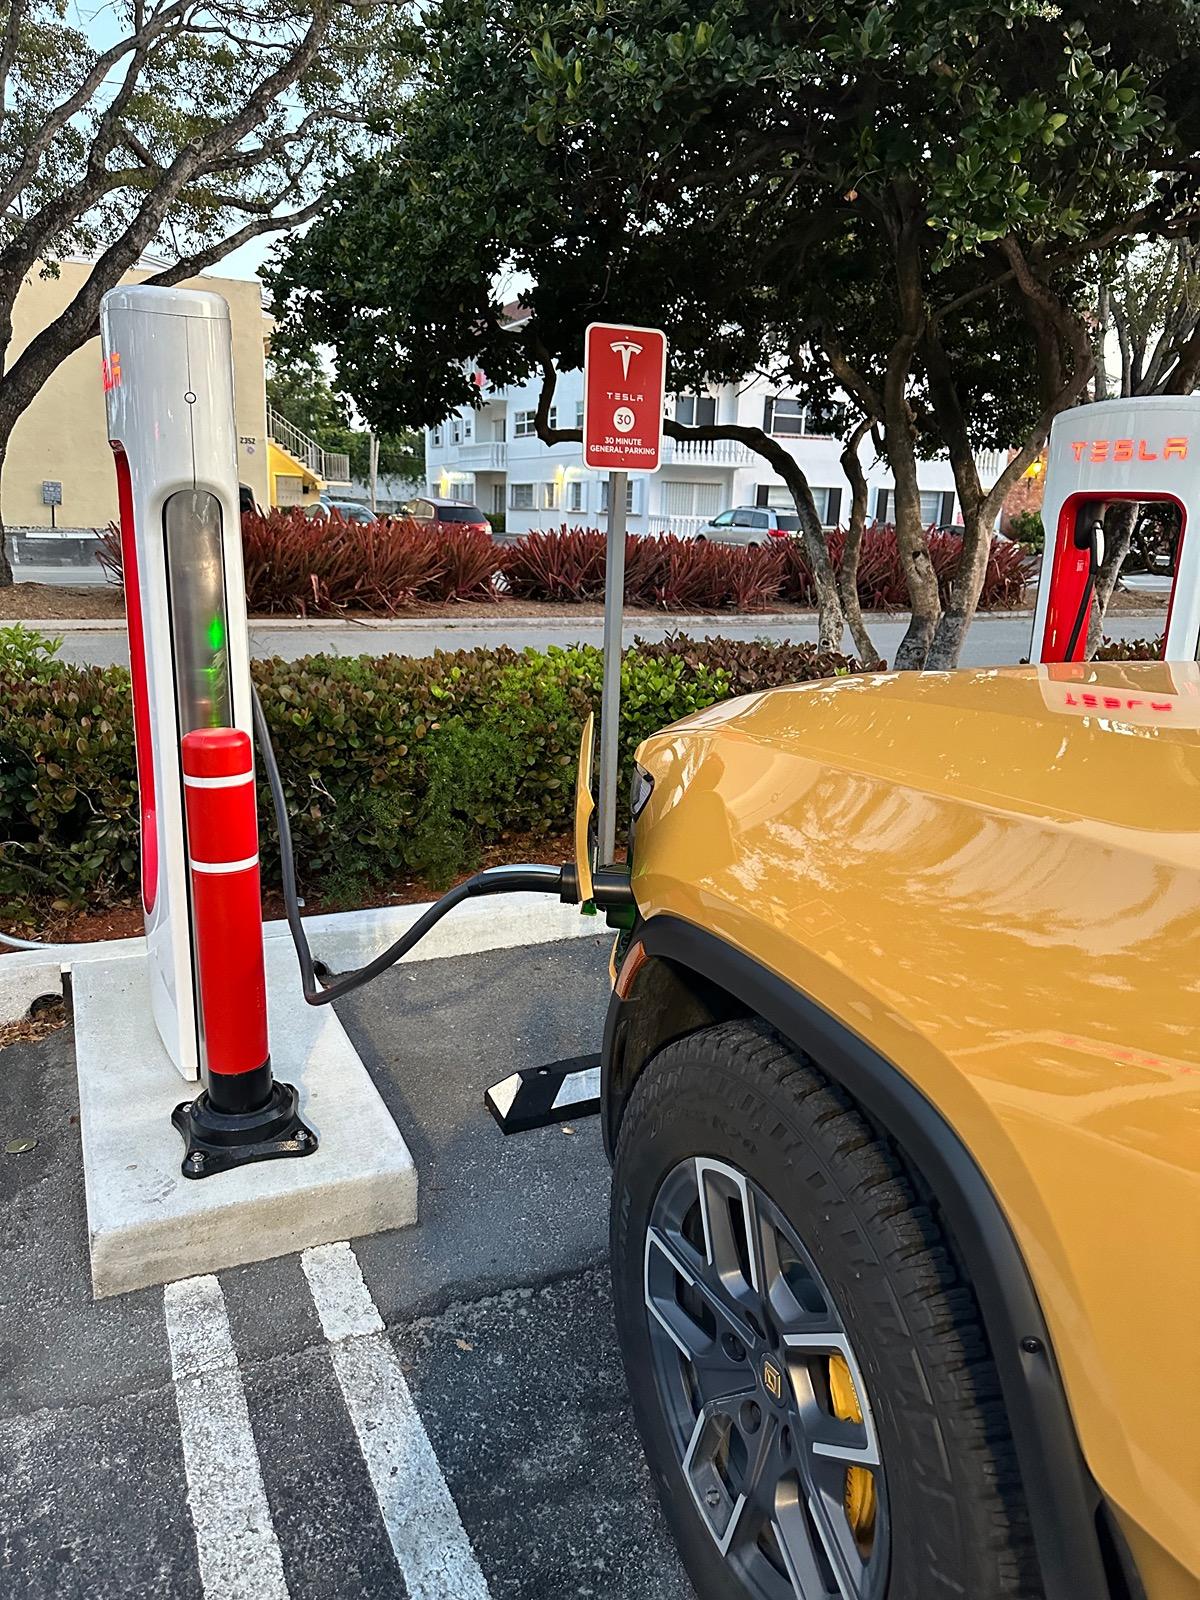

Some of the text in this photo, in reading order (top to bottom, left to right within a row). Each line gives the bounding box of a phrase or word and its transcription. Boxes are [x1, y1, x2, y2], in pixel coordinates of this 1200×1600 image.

[606, 391, 644, 402] TESLA
[617, 414, 632, 425] 30
[604, 436, 642, 446] 30 MINUTE
[590, 444, 655, 456] GENERAL PARKING
[1071, 437, 1189, 463] TESLA
